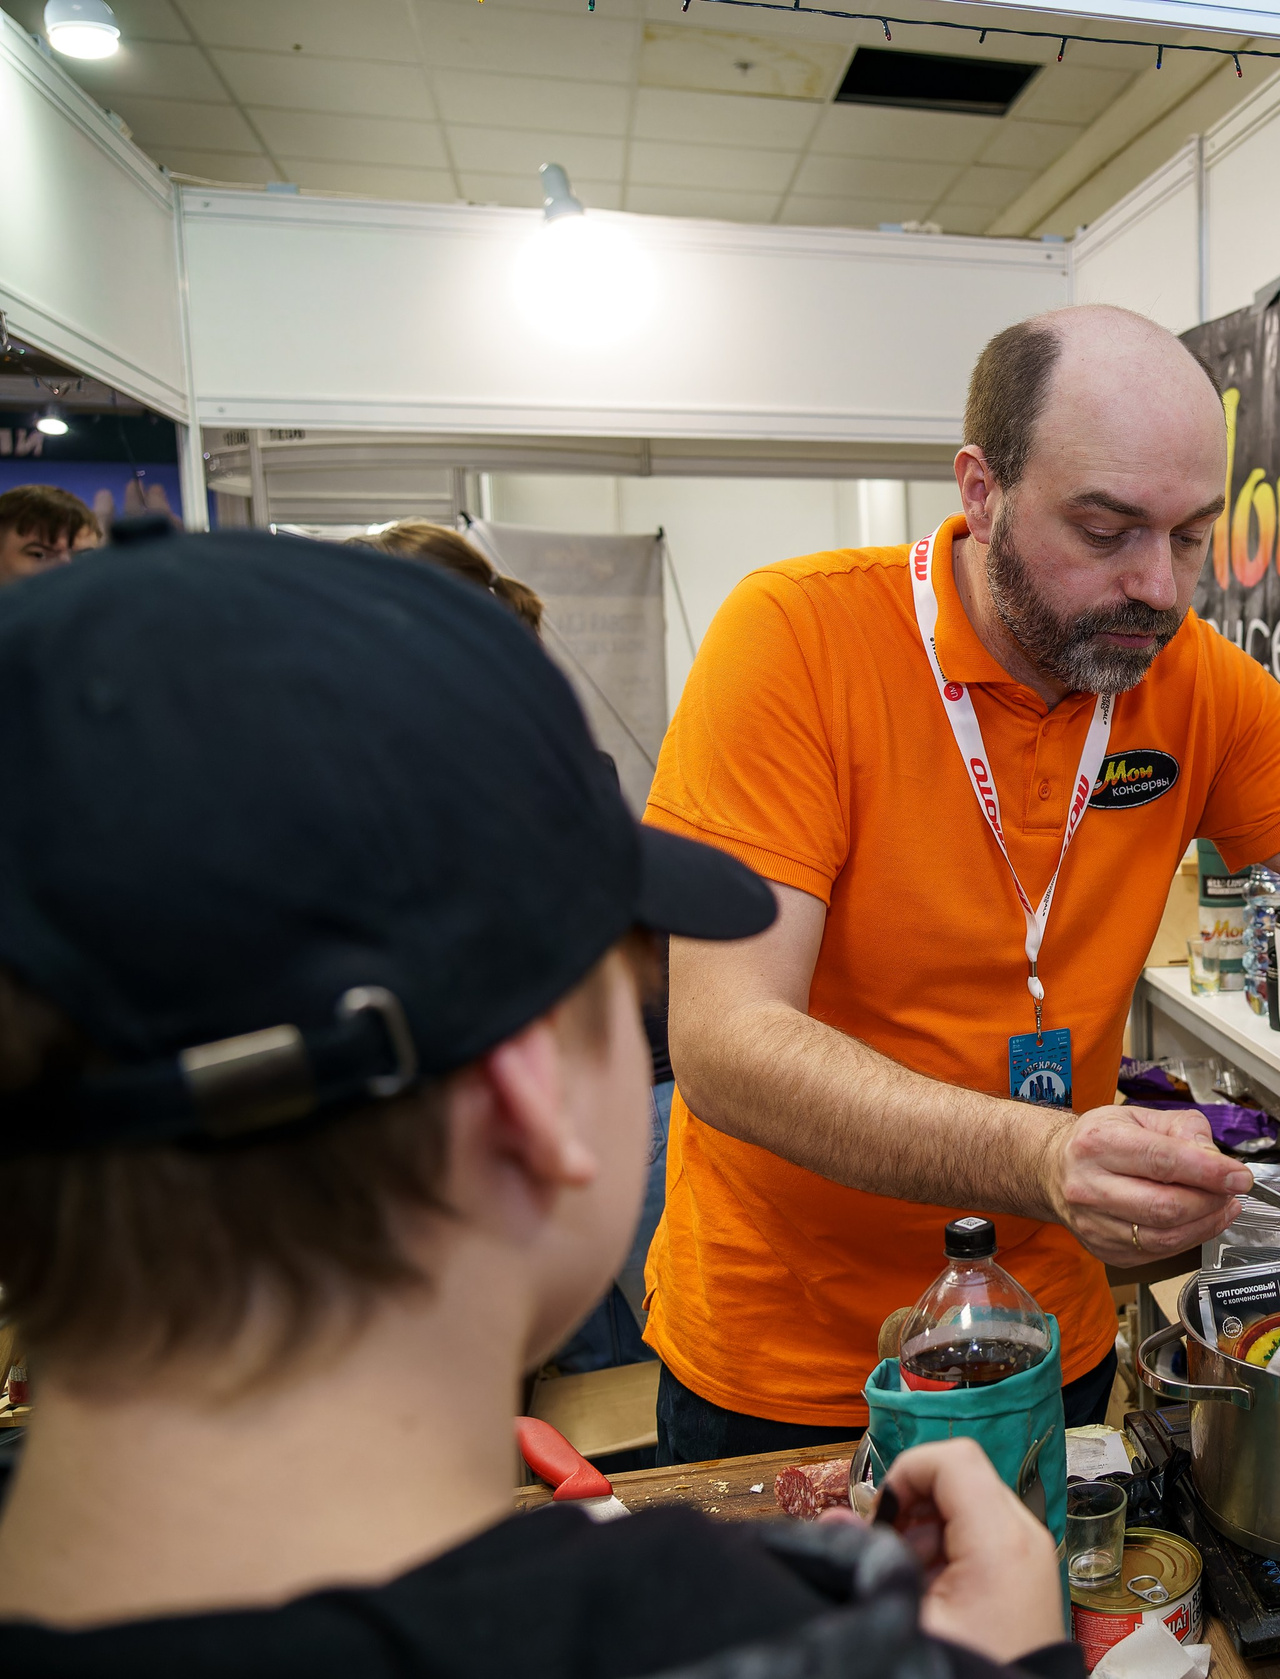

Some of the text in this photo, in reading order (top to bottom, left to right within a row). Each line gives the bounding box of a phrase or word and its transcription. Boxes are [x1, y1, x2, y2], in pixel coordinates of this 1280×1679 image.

[1104, 760, 1153, 786] Мои
[1112, 777, 1170, 797] консервы
[1216, 1280, 1277, 1299] СУП ГОРОХОВЫЙ
